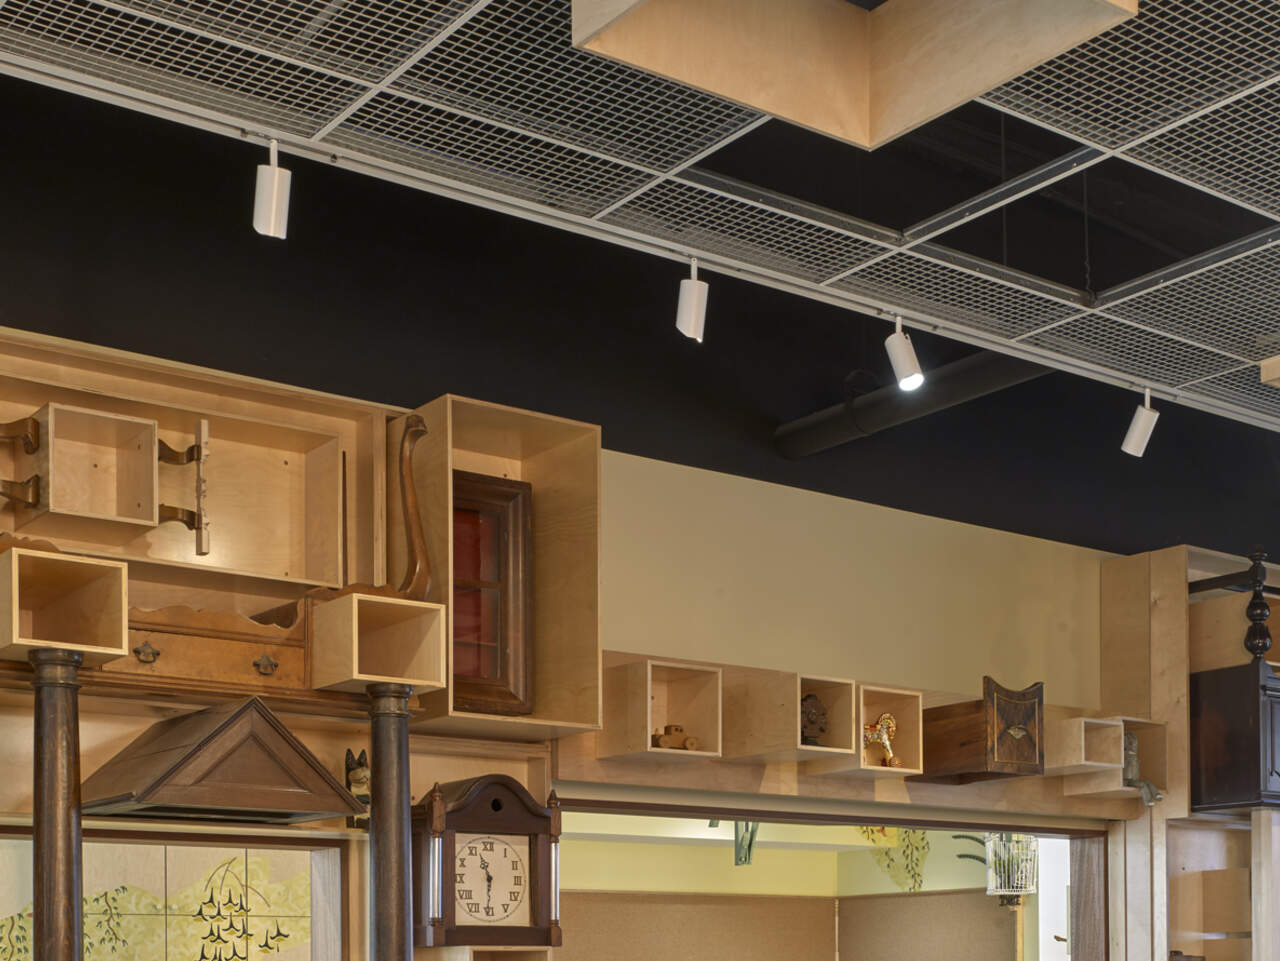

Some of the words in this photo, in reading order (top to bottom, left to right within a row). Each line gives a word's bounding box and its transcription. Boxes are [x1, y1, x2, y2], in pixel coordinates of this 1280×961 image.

[468, 846, 478, 856] XI
[481, 841, 495, 852] XII
[459, 858, 466, 868] X
[511, 860, 518, 870] II
[513, 876, 522, 886] III
[457, 889, 473, 900] VIII
[509, 891, 520, 901] IV
[466, 903, 480, 913] VII
[501, 903, 510, 913] V
